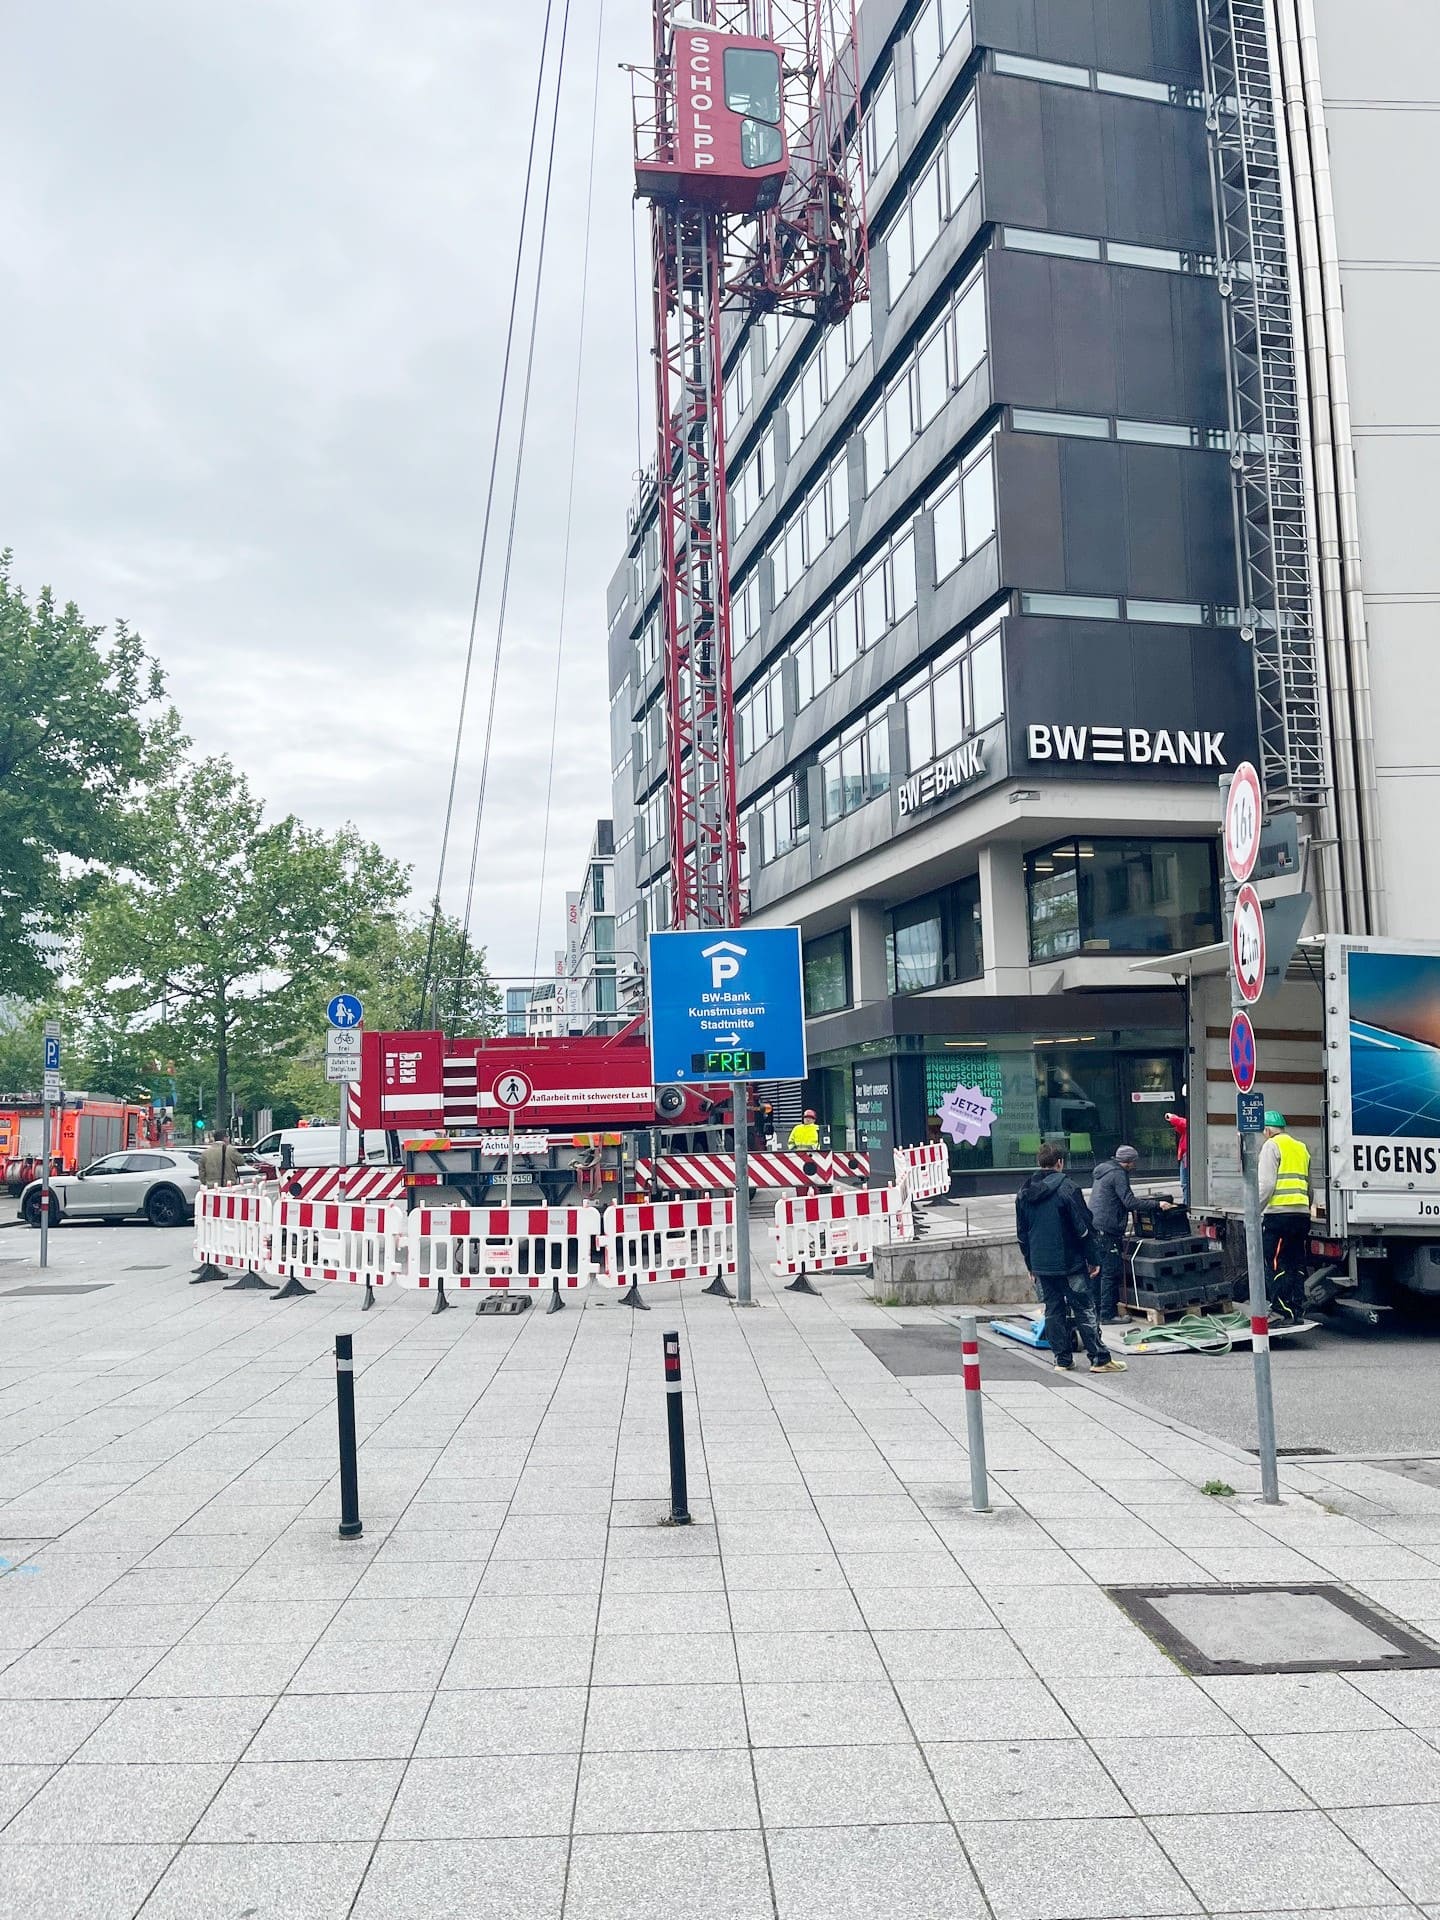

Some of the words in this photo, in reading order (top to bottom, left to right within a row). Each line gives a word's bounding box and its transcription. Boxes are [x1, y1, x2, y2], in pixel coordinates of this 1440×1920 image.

[690, 36, 715, 169] SCHOLPP
[702, 991, 751, 1003] BW-Bank
[688, 1006, 765, 1017] Kunstmuseum
[700, 1019, 755, 1030] Stadtmitte
[708, 1052, 750, 1072] FREI
[926, 1062, 1002, 1072] #NeuesSchaffen
[927, 1071, 1003, 1080] #NeuesSchaffen
[927, 1079, 1003, 1089] #NeueSchaffen
[587, 1092, 629, 1100] schwerster
[631, 1091, 648, 1099] Last
[951, 1097, 987, 1116] JETZT
[485, 1142, 520, 1150] Achtug
[1353, 1144, 1440, 1174] EIGENS
[1418, 1200, 1440, 1216] Joo
